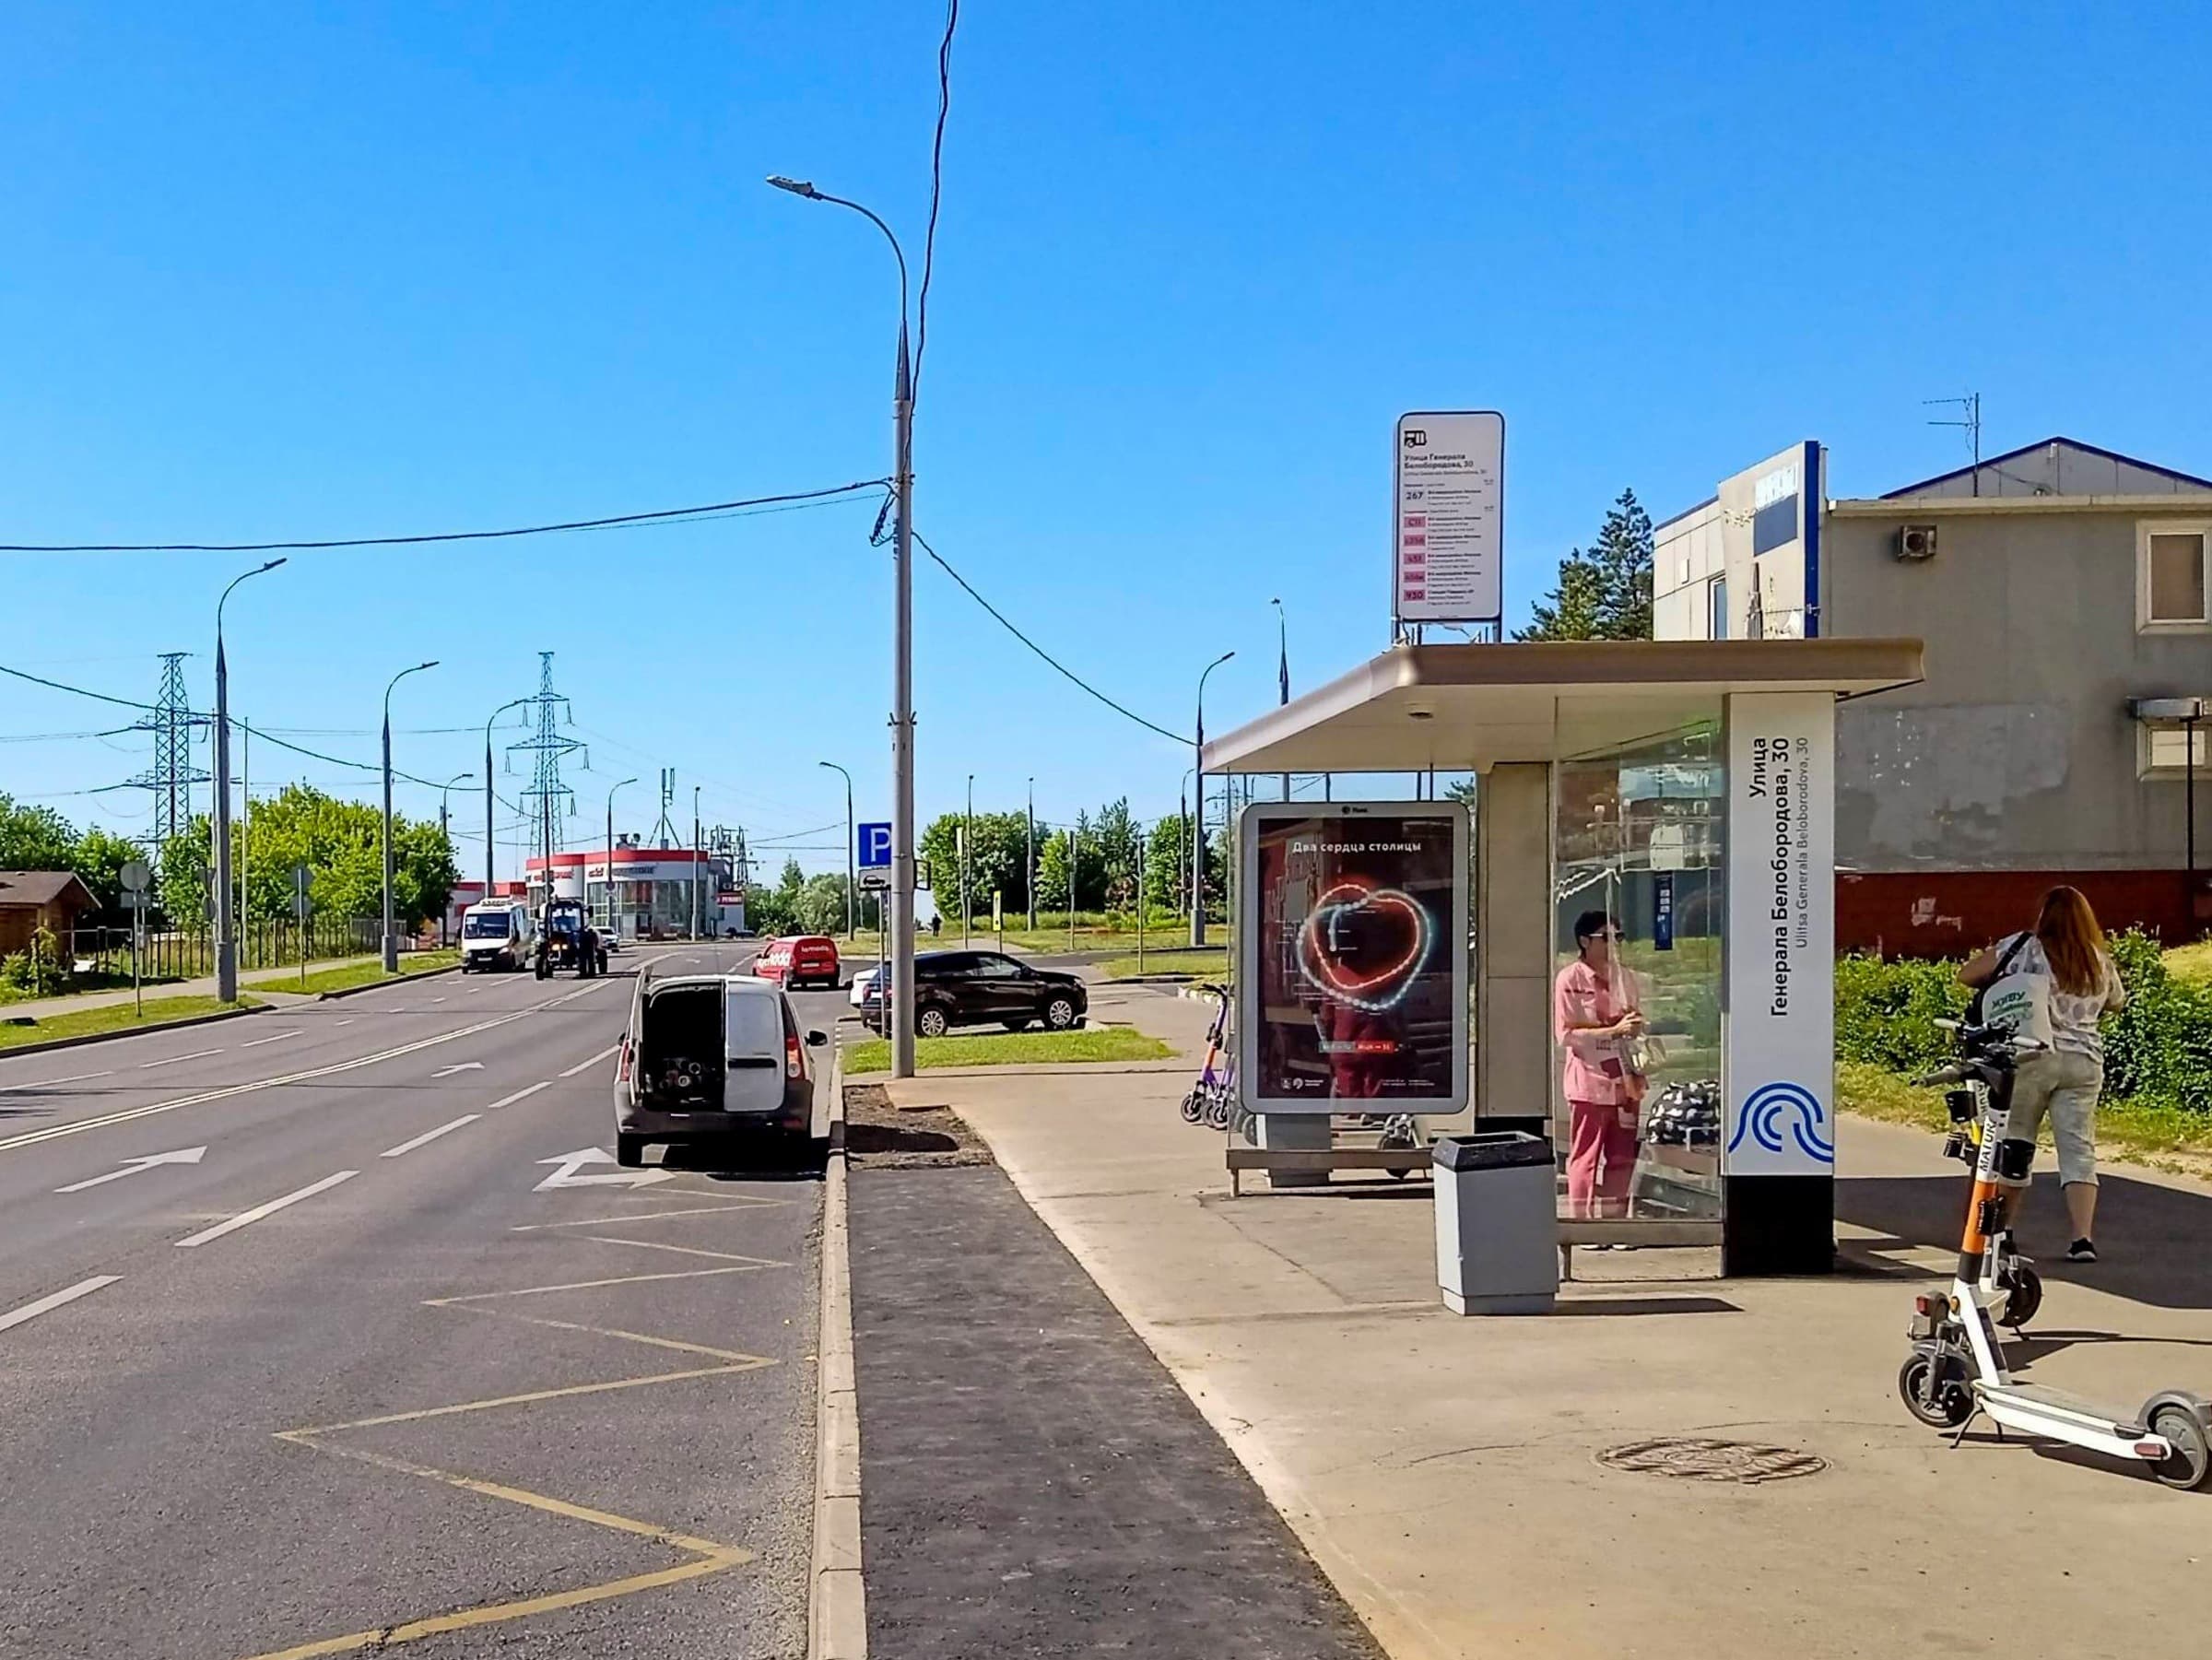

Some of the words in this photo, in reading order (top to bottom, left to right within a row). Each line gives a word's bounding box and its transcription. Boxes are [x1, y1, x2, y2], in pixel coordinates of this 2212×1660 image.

[1748, 737, 1769, 798] Улица
[1771, 737, 1789, 763] 30
[1796, 737, 1808, 755] 30
[870, 828, 891, 863] P
[1292, 842, 1317, 854] Два
[1320, 842, 1366, 854] сердца
[1369, 842, 1422, 854] столицы
[1771, 768, 1793, 921] Белобородова,
[1795, 853, 1808, 910] Generala
[1771, 925, 1792, 1017] Генерала
